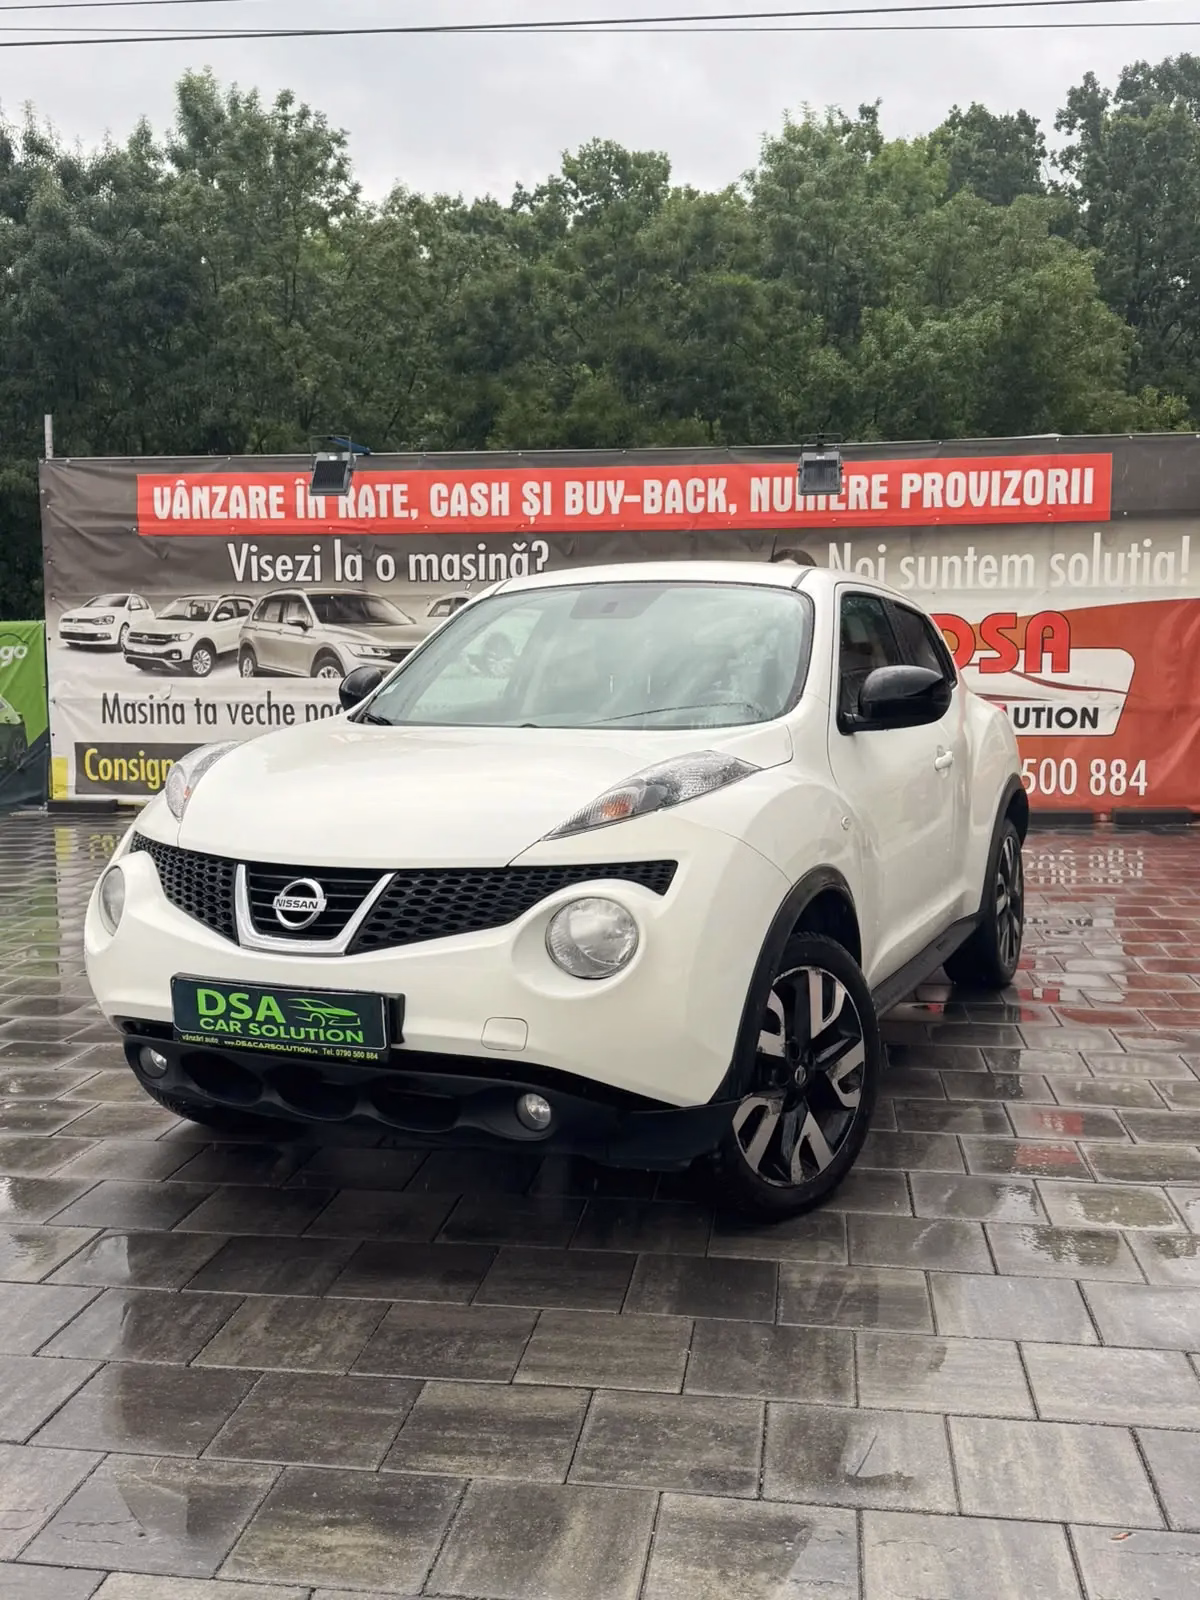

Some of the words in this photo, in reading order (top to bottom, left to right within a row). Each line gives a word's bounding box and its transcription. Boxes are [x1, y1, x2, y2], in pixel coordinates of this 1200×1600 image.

[153, 479, 286, 520] VÂNZARE
[294, 478, 326, 519] ÎN
[338, 483, 419, 520] RATE,
[429, 482, 510, 518] CASH
[521, 480, 553, 524] ȘI
[564, 477, 737, 516] BUY-BACK,
[901, 467, 1094, 509] PROVIZORII
[227, 542, 322, 582] Visezi
[334, 538, 364, 582] la
[376, 553, 396, 582] o
[899, 546, 1036, 590] suntem
[929, 610, 1071, 674] DSA
[195, 697, 217, 725] ta
[226, 690, 295, 726] veche
[1089, 758, 1148, 796] 884
[275, 898, 319, 909] NISSAN
[196, 988, 286, 1023] DSA
[200, 1017, 243, 1034] CAR
[248, 1022, 364, 1043] SOLUTION
